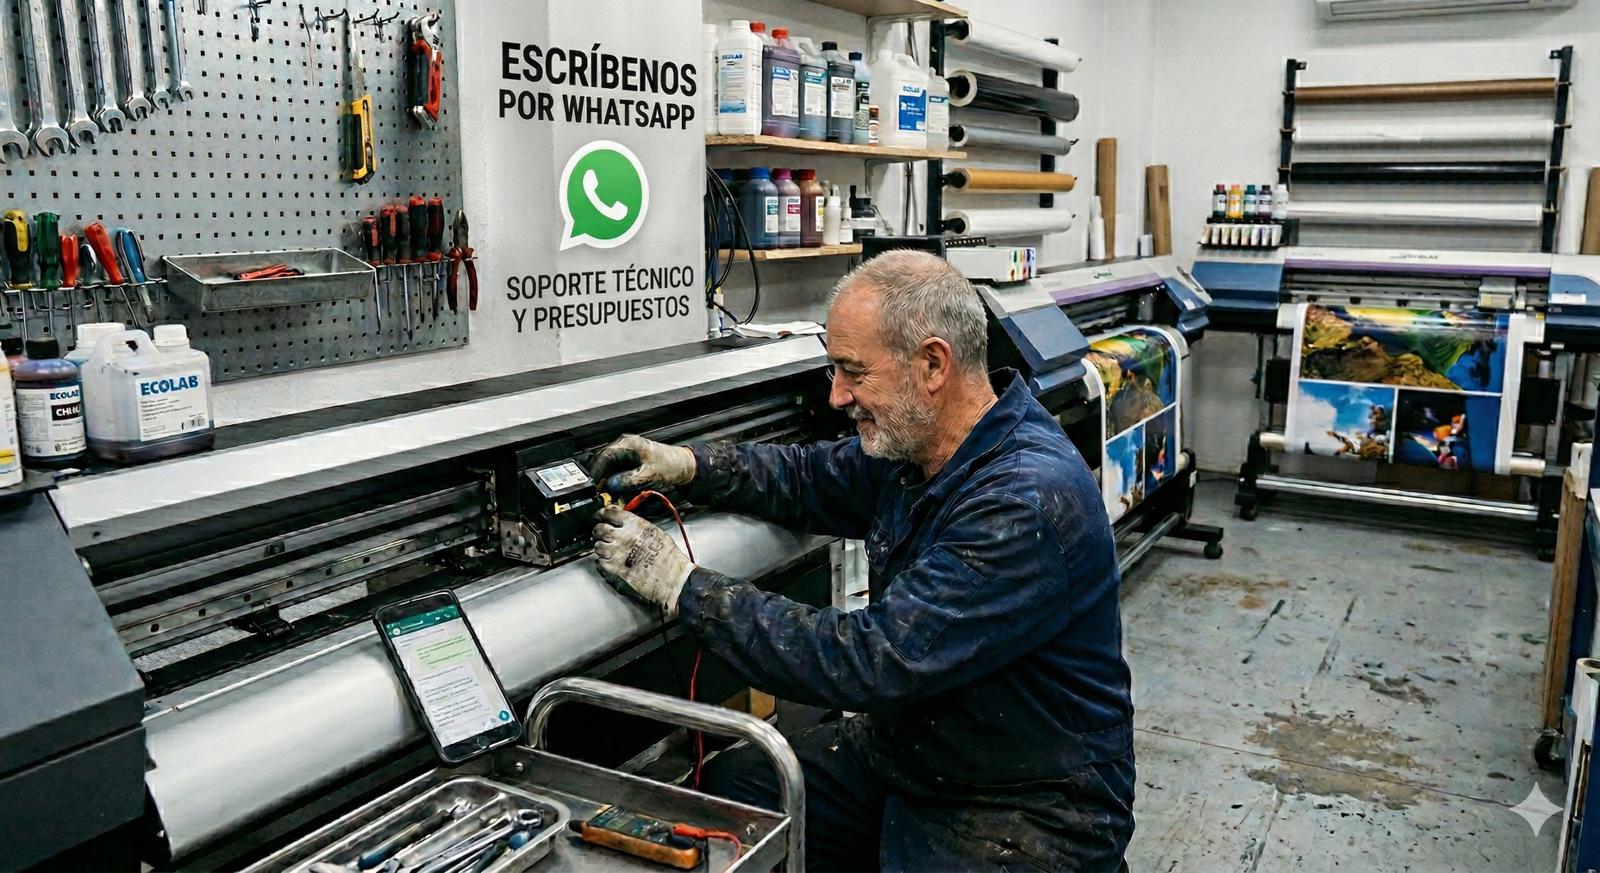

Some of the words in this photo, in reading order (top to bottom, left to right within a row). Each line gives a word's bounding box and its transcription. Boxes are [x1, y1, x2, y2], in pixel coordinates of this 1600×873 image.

[501, 41, 697, 97] ESCRÍBENOS
[499, 88, 555, 121] POR
[562, 93, 695, 130] WHATSAPP
[506, 270, 607, 301] SOPORTE
[612, 263, 694, 293] TÉCNICO
[512, 308, 527, 333] Y
[534, 295, 690, 331] PRESUPUESTOS
[140, 375, 199, 396] ECOLAB
